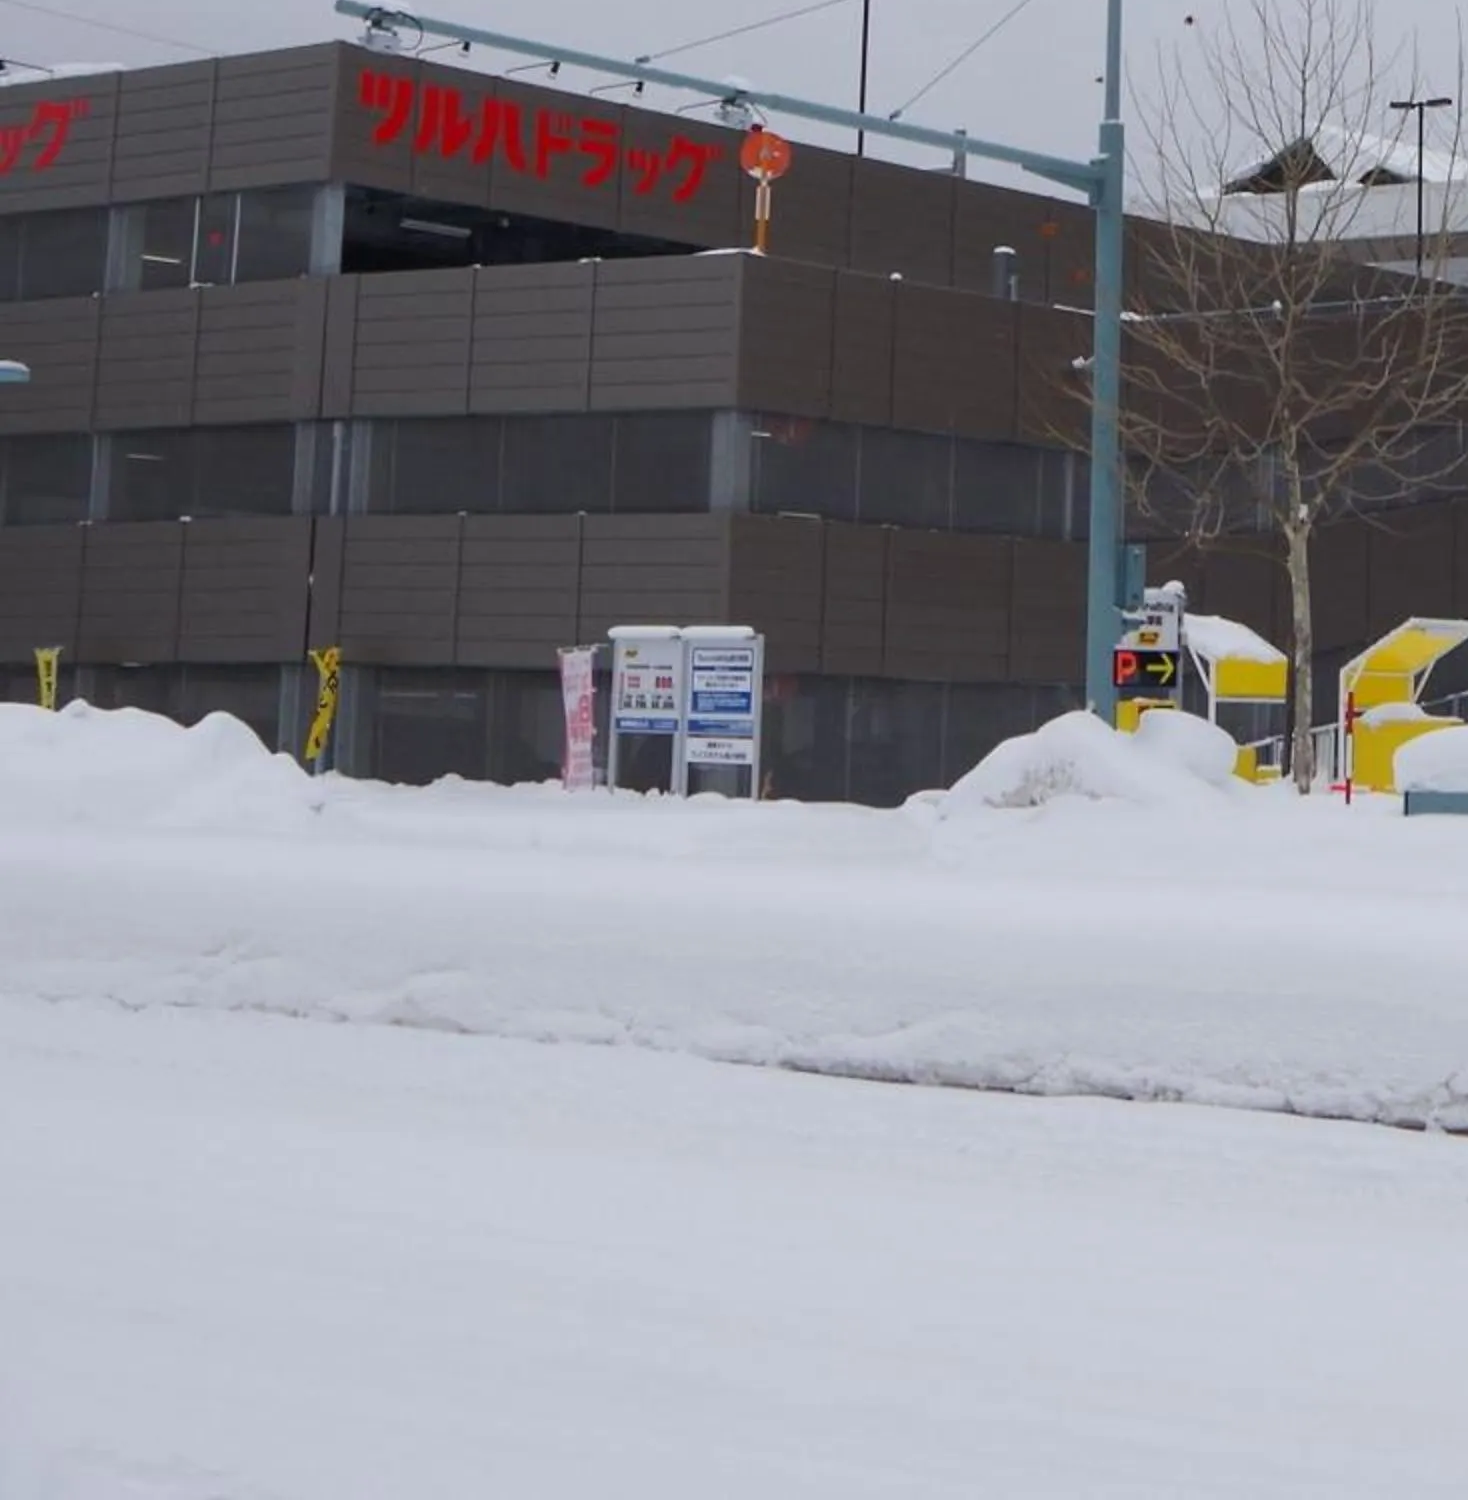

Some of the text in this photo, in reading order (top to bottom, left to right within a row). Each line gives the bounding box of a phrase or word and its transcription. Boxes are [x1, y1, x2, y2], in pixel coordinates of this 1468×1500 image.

[358, 68, 723, 203] ツルハドラッグ
[1116, 650, 1138, 686] P
